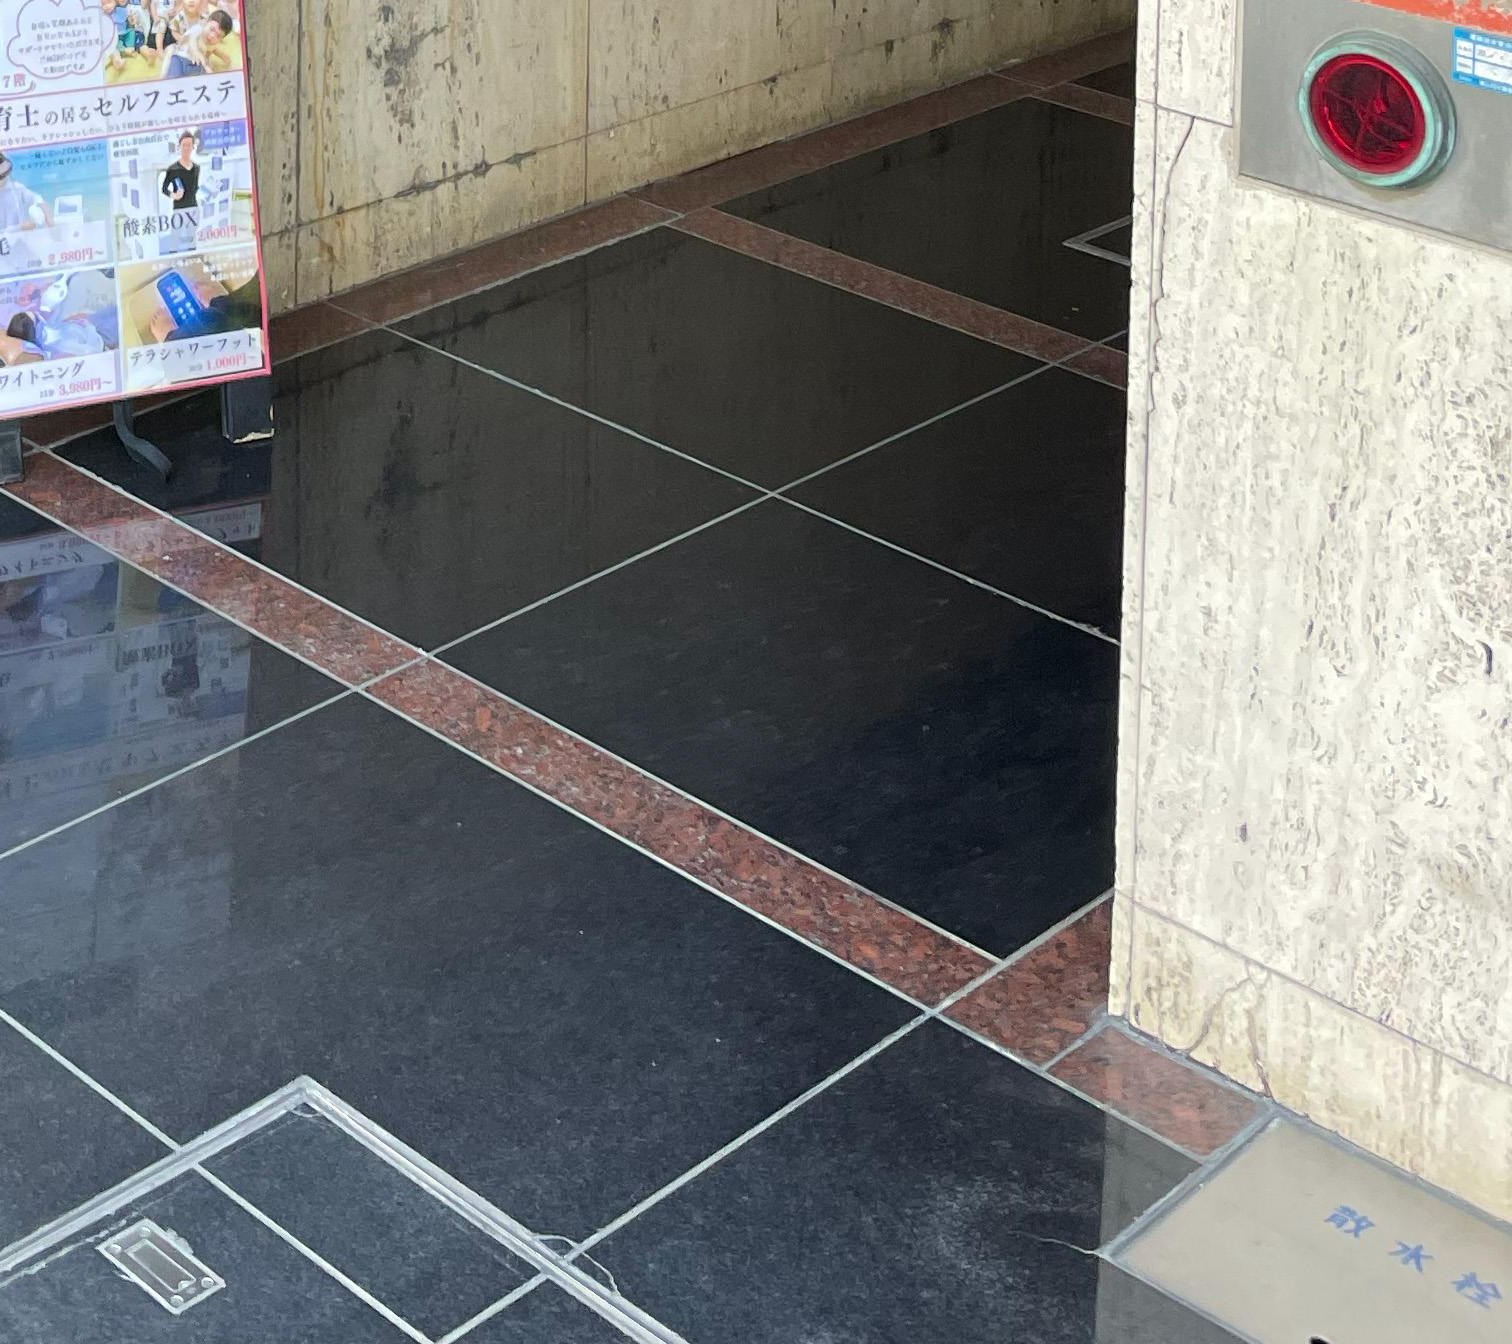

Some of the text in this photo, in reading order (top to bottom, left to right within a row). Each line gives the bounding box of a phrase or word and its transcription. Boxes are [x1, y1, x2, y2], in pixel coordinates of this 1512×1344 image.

[123, 211, 199, 238] 酸素BOX
[130, 333, 257, 368] テラシャワーフット
